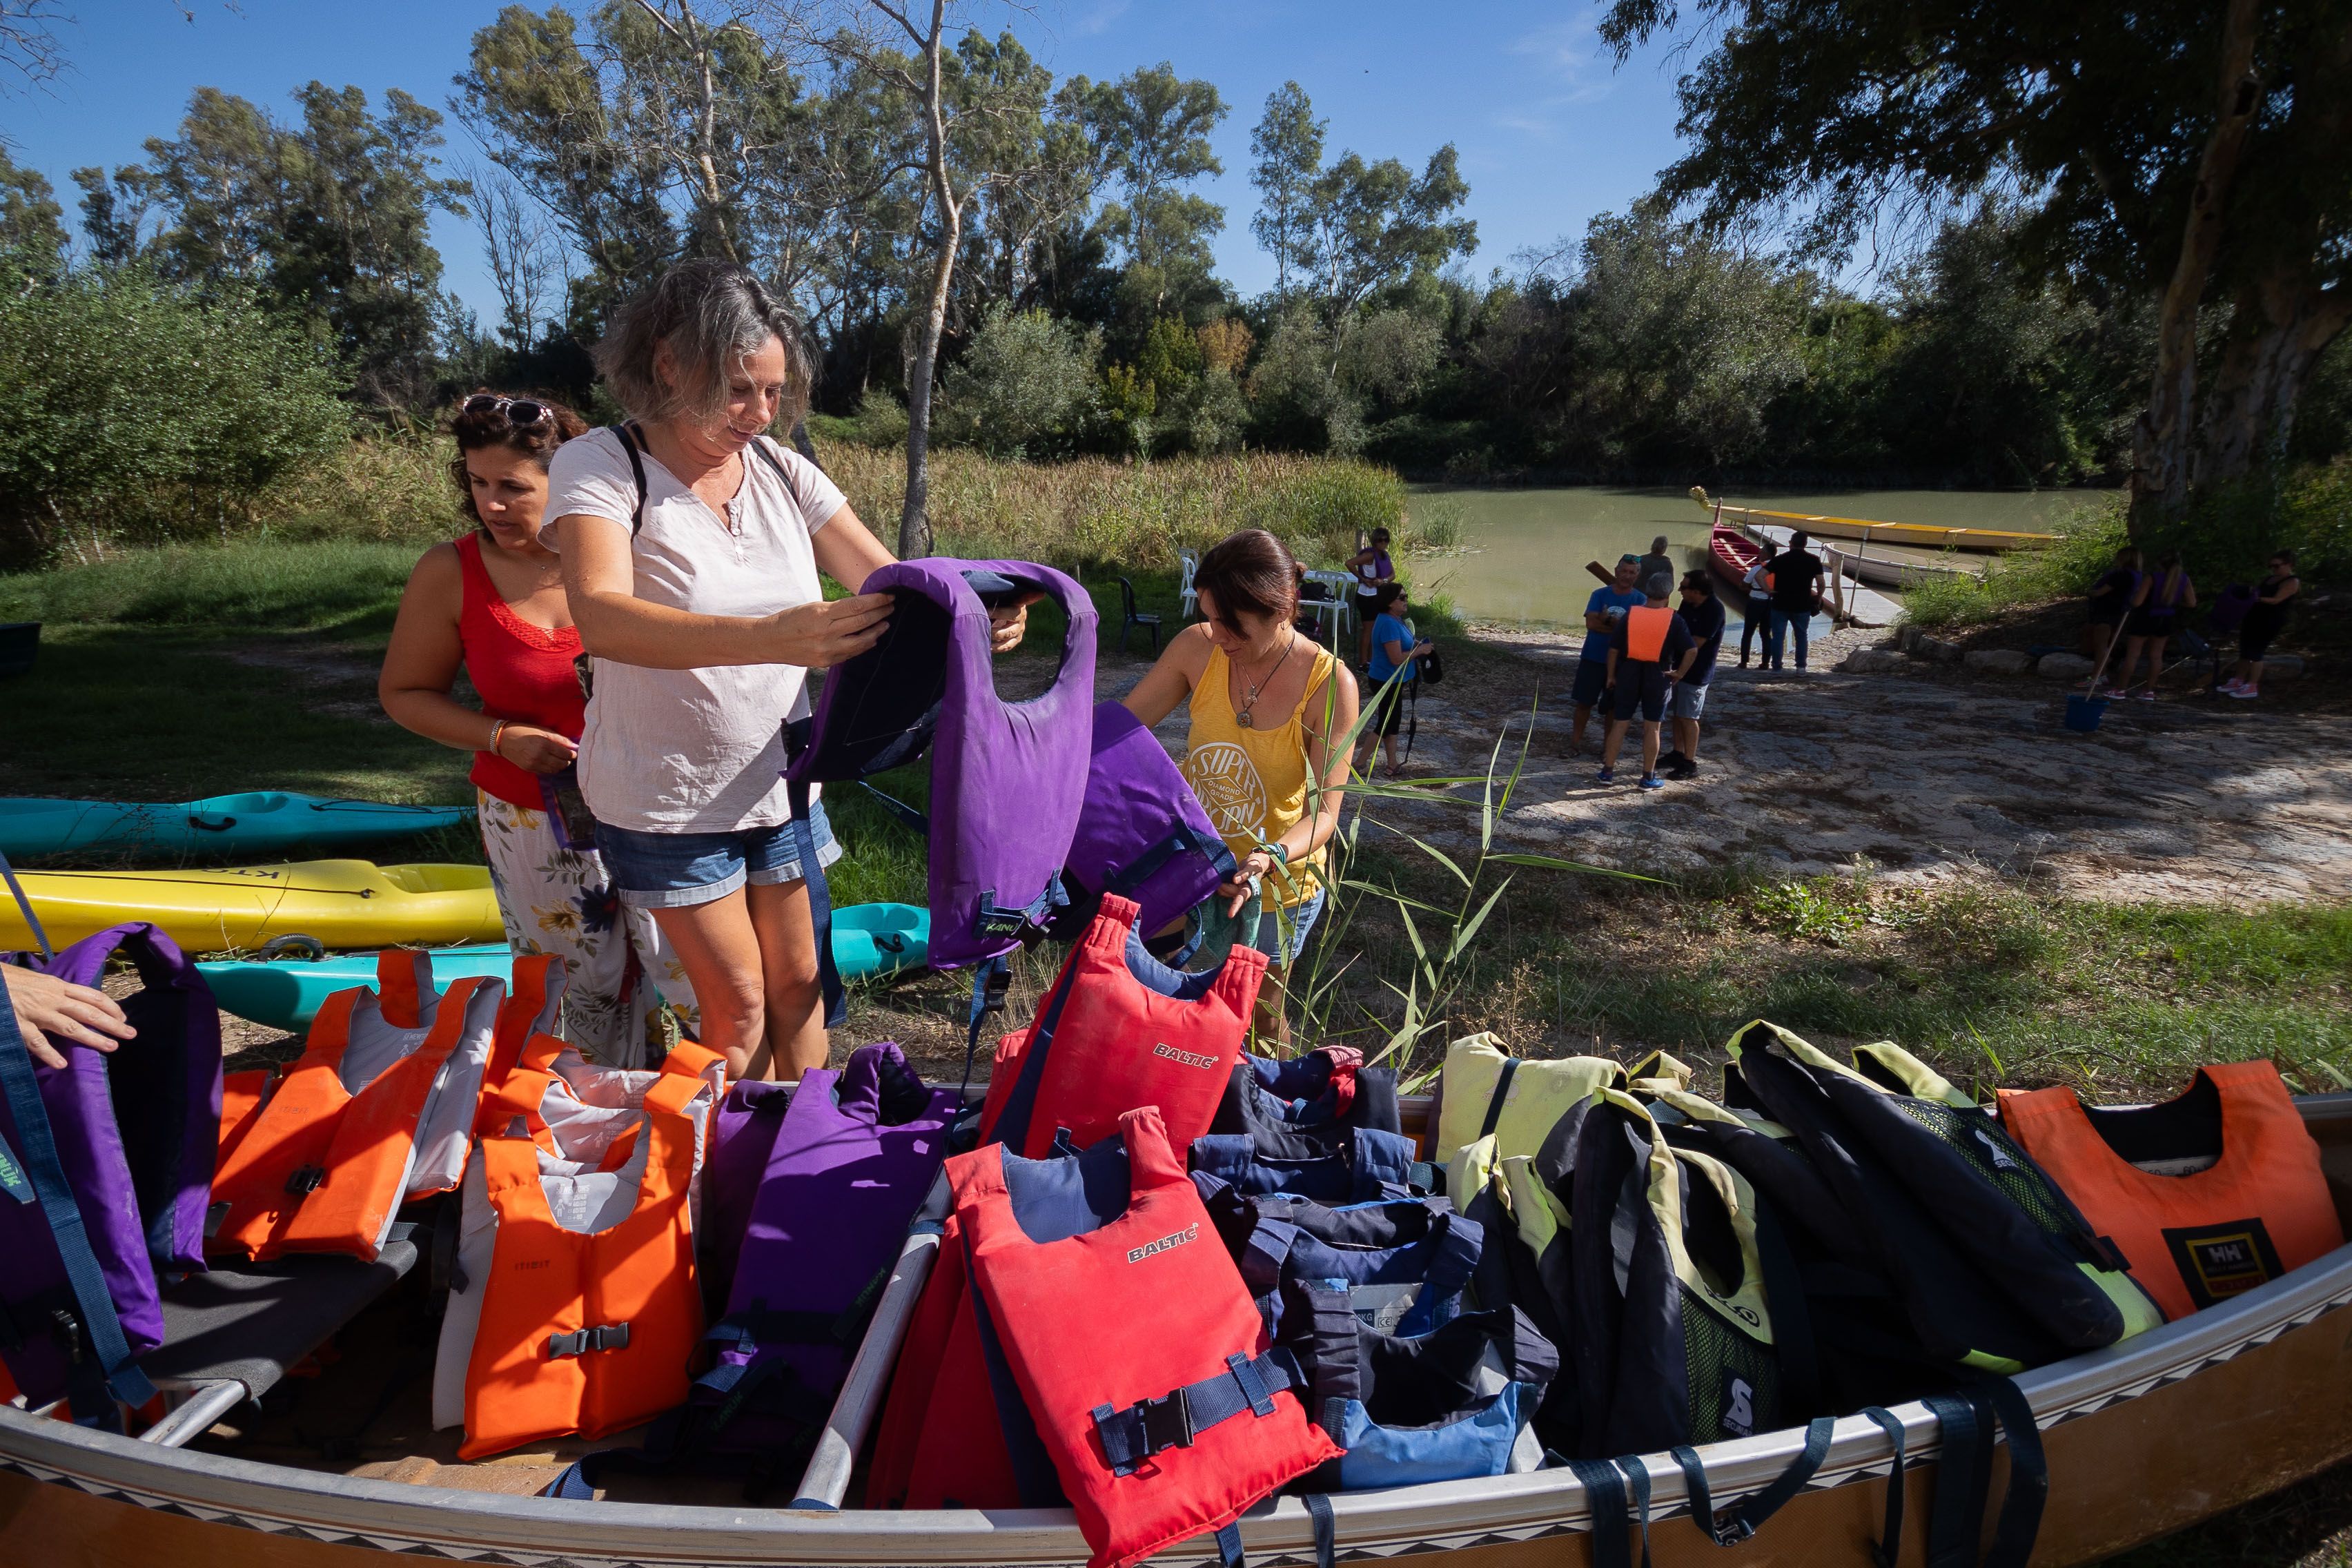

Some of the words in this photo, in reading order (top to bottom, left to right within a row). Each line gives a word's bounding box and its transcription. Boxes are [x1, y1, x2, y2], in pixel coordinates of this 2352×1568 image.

[1197, 749, 1255, 798] SUPER
[1208, 780, 1241, 795] DIAMOND
[1210, 789, 1234, 802] GRADE
[1153, 1043, 1215, 1069] BALTIC
[1127, 1227, 1198, 1264] BALTIC
